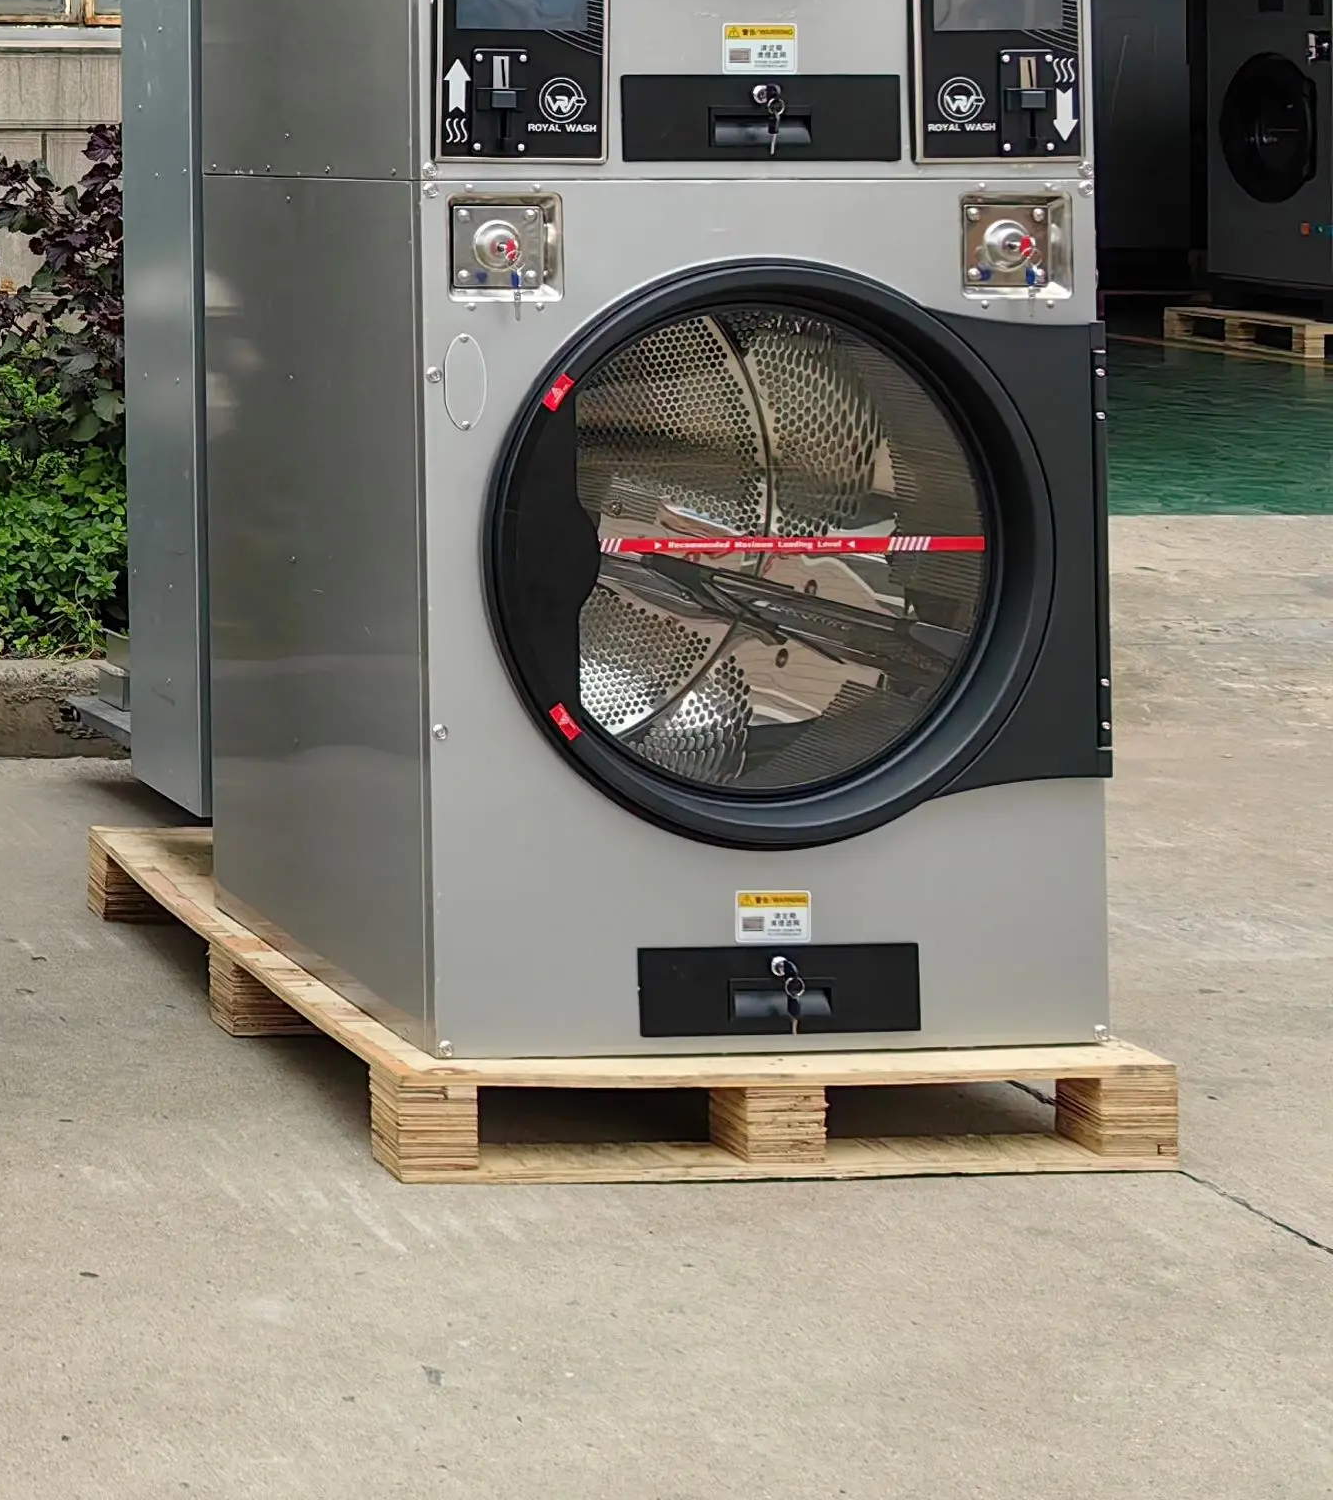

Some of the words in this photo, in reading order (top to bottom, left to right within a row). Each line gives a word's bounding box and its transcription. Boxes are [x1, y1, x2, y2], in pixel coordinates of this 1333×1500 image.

[527, 123, 562, 133] ROYAL
[565, 124, 597, 133] WASH
[928, 123, 961, 132] ROYAL
[964, 122, 996, 132] WASH
